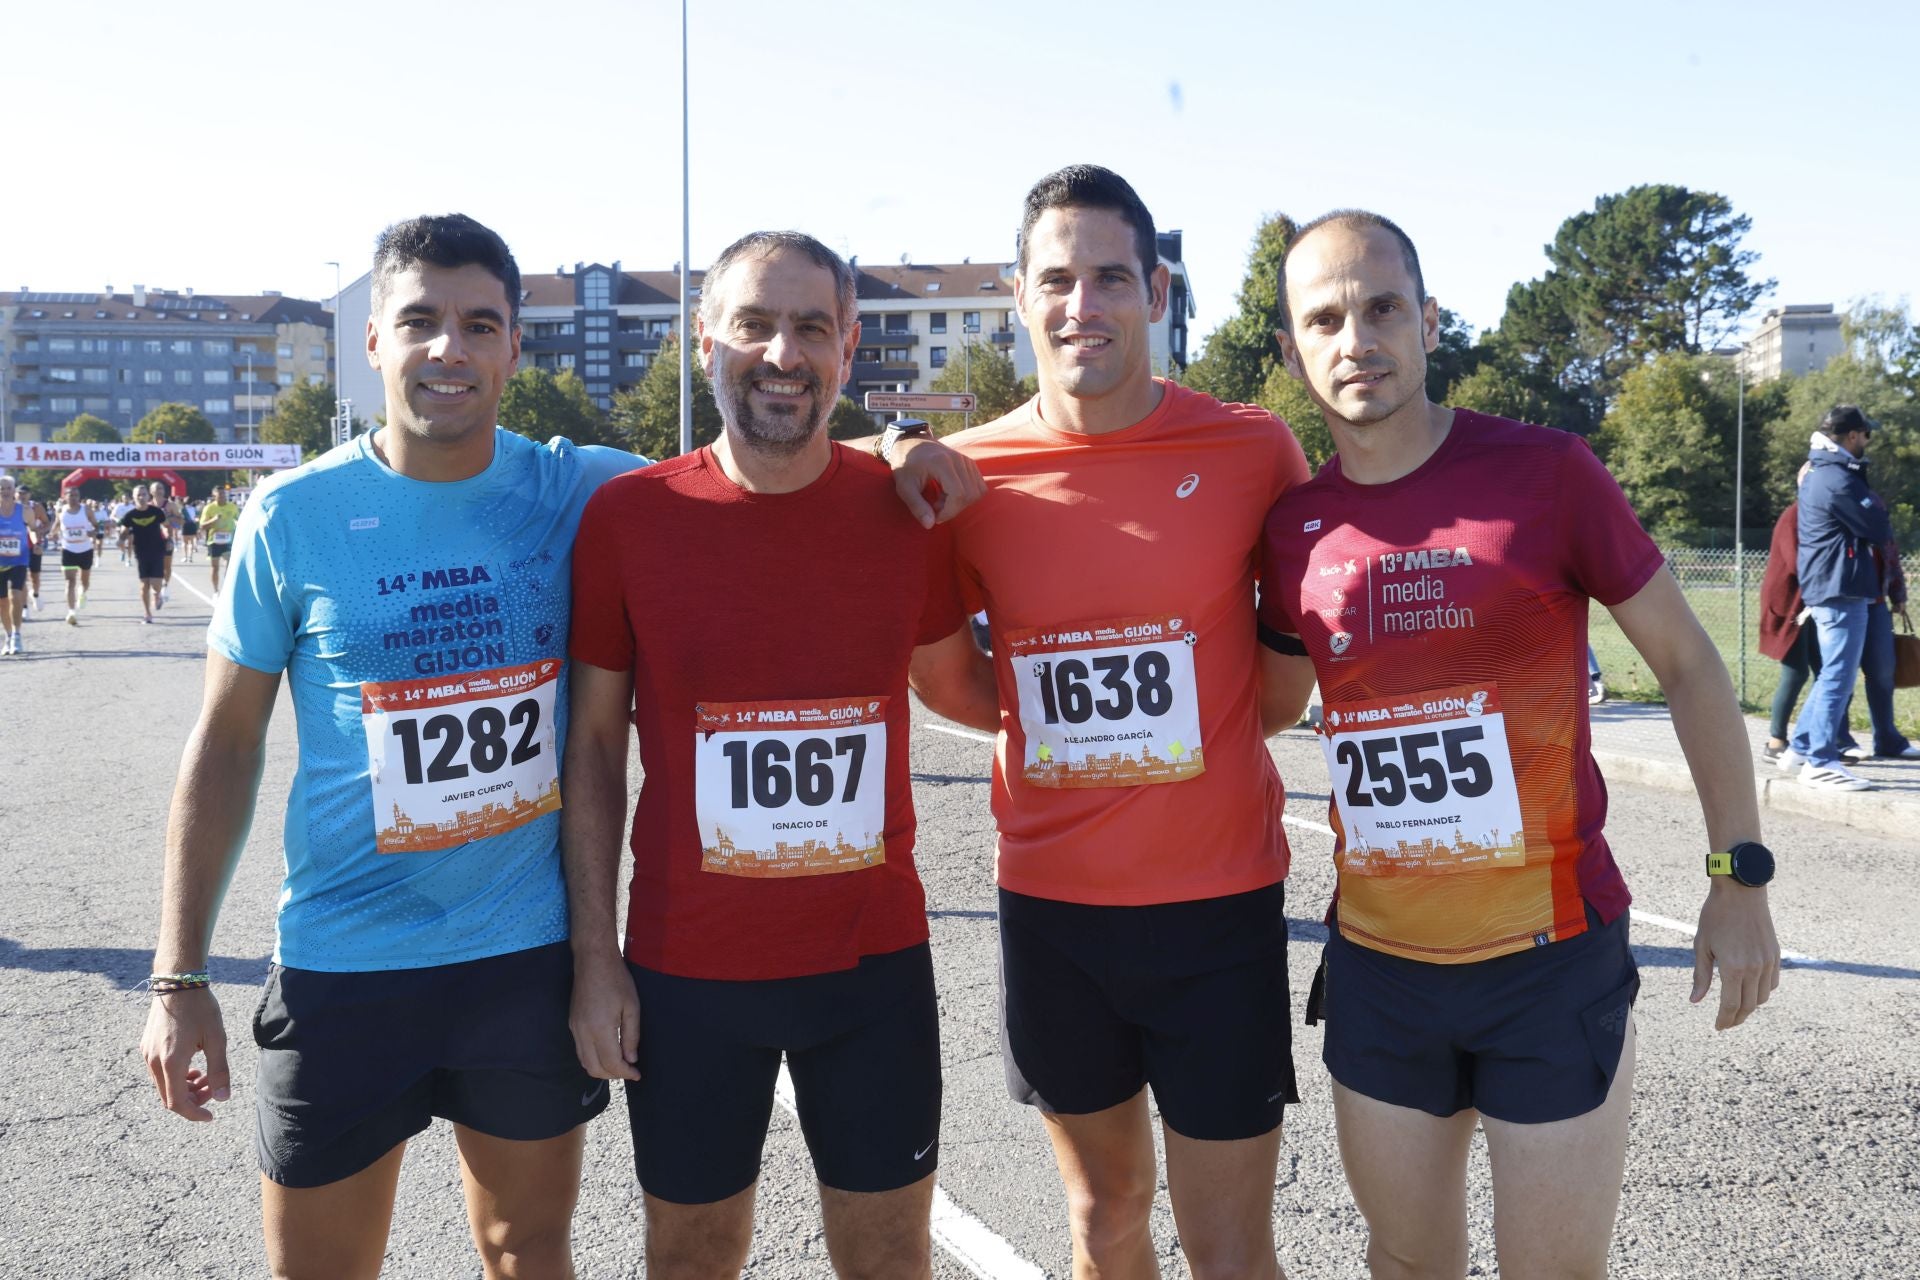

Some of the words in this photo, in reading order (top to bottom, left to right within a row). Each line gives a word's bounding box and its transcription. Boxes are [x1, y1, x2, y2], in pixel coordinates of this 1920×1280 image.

[15, 446, 40, 461] 14
[44, 450, 85, 461] MBA
[90, 447, 141, 461] media
[145, 448, 219, 461] maratón
[225, 447, 264, 459] GIJÓN
[1379, 553, 1402, 573] 13ª
[1403, 546, 1473, 571] MBA
[376, 573, 416, 595] 14ª
[422, 565, 492, 590] MBA
[1382, 575, 1444, 604] media
[410, 593, 499, 622] media
[1384, 602, 1475, 632] maratón
[383, 616, 503, 650] maratón
[1058, 631, 1093, 644] MBA
[1095, 633, 1123, 641] maratón
[1124, 623, 1162, 638] GIJÓN
[414, 640, 505, 675] GIJÓN
[468, 678, 491, 687] media
[500, 670, 536, 688] GIJÓN
[427, 683, 466, 699] MBA
[469, 683, 498, 693] maratón
[1034, 651, 1173, 725] 1638
[829, 704, 862, 720] GIJÓN
[1392, 703, 1414, 713] media
[1393, 708, 1423, 719] maratón
[1423, 697, 1466, 714] GIJÓN
[757, 710, 797, 722] MBA
[800, 714, 828, 722] maratón
[1357, 708, 1392, 723] MBA
[392, 698, 541, 785] 1282
[1064, 732, 1115, 744] ALEJANDRO
[1117, 729, 1153, 742] GARCÍA
[723, 733, 867, 809] 1667
[1336, 725, 1493, 807] 2555
[441, 790, 475, 803] JAVIER
[477, 780, 513, 796] CUERVO
[772, 820, 814, 830] IGNACIO
[815, 820, 828, 828] DE
[1376, 821, 1401, 829] PABLO
[1403, 815, 1461, 828] FERNANDEZ
